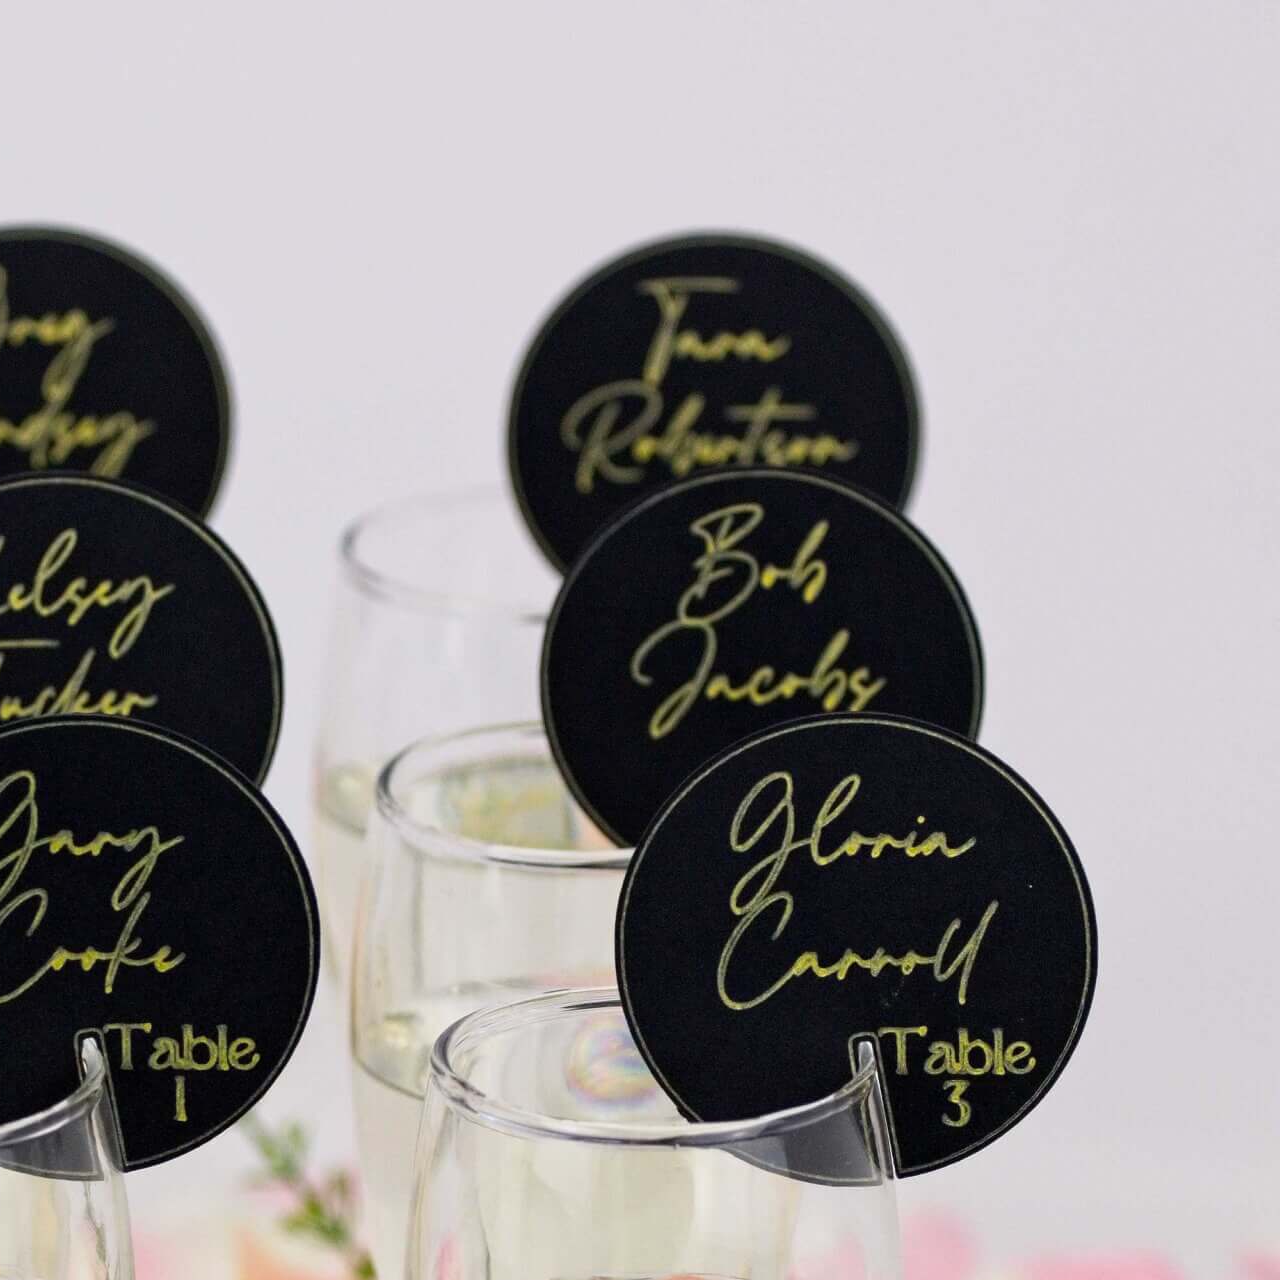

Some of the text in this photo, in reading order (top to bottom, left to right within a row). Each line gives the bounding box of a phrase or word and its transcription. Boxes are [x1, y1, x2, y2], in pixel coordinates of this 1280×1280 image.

[637, 275, 791, 387] Tara
[677, 502, 829, 626] Bob
[630, 618, 887, 739] Jacobs
[729, 771, 977, 915] Gloria
[716, 891, 999, 1011] Carroll
[103, 1022, 260, 1071] Table
[877, 1025, 1036, 1075] Table
[941, 1080, 971, 1127] 3
